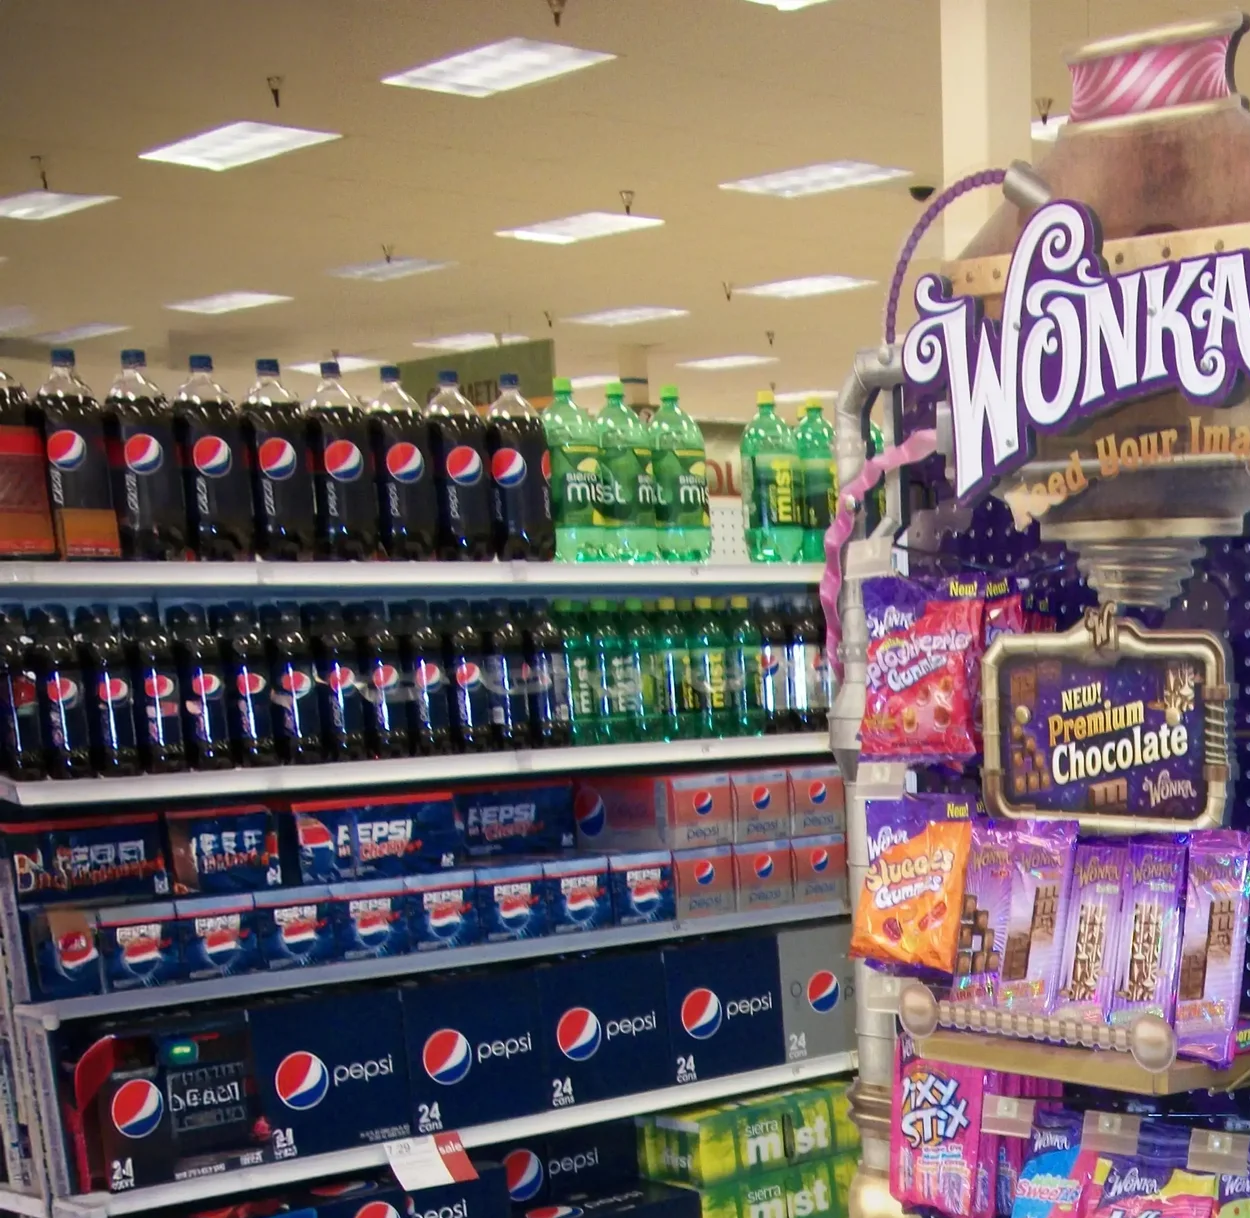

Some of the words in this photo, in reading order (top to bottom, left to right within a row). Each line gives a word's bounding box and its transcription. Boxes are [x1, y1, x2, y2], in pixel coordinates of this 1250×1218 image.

[1096, 427, 1177, 476] Your
[1061, 682, 1102, 712] NEW!
[1049, 700, 1145, 746] Premium
[1052, 723, 1188, 785] Chocolate
[1142, 769, 1197, 808] WONKA
[726, 992, 772, 1020] pepsi
[606, 1011, 657, 1041] pepsi
[477, 1032, 532, 1063] pepsi
[789, 1033, 806, 1050] 24
[334, 1054, 394, 1087] pepsi
[676, 1055, 695, 1075] 24
[553, 1077, 572, 1097] 24
[418, 1102, 440, 1123] 24
[745, 1119, 778, 1137] sierra
[747, 1115, 829, 1165] mst
[439, 1140, 462, 1155] sale
[548, 1148, 599, 1178] pepsi
[748, 1185, 781, 1201] sierra
[1110, 1167, 1161, 1198] WONKA
